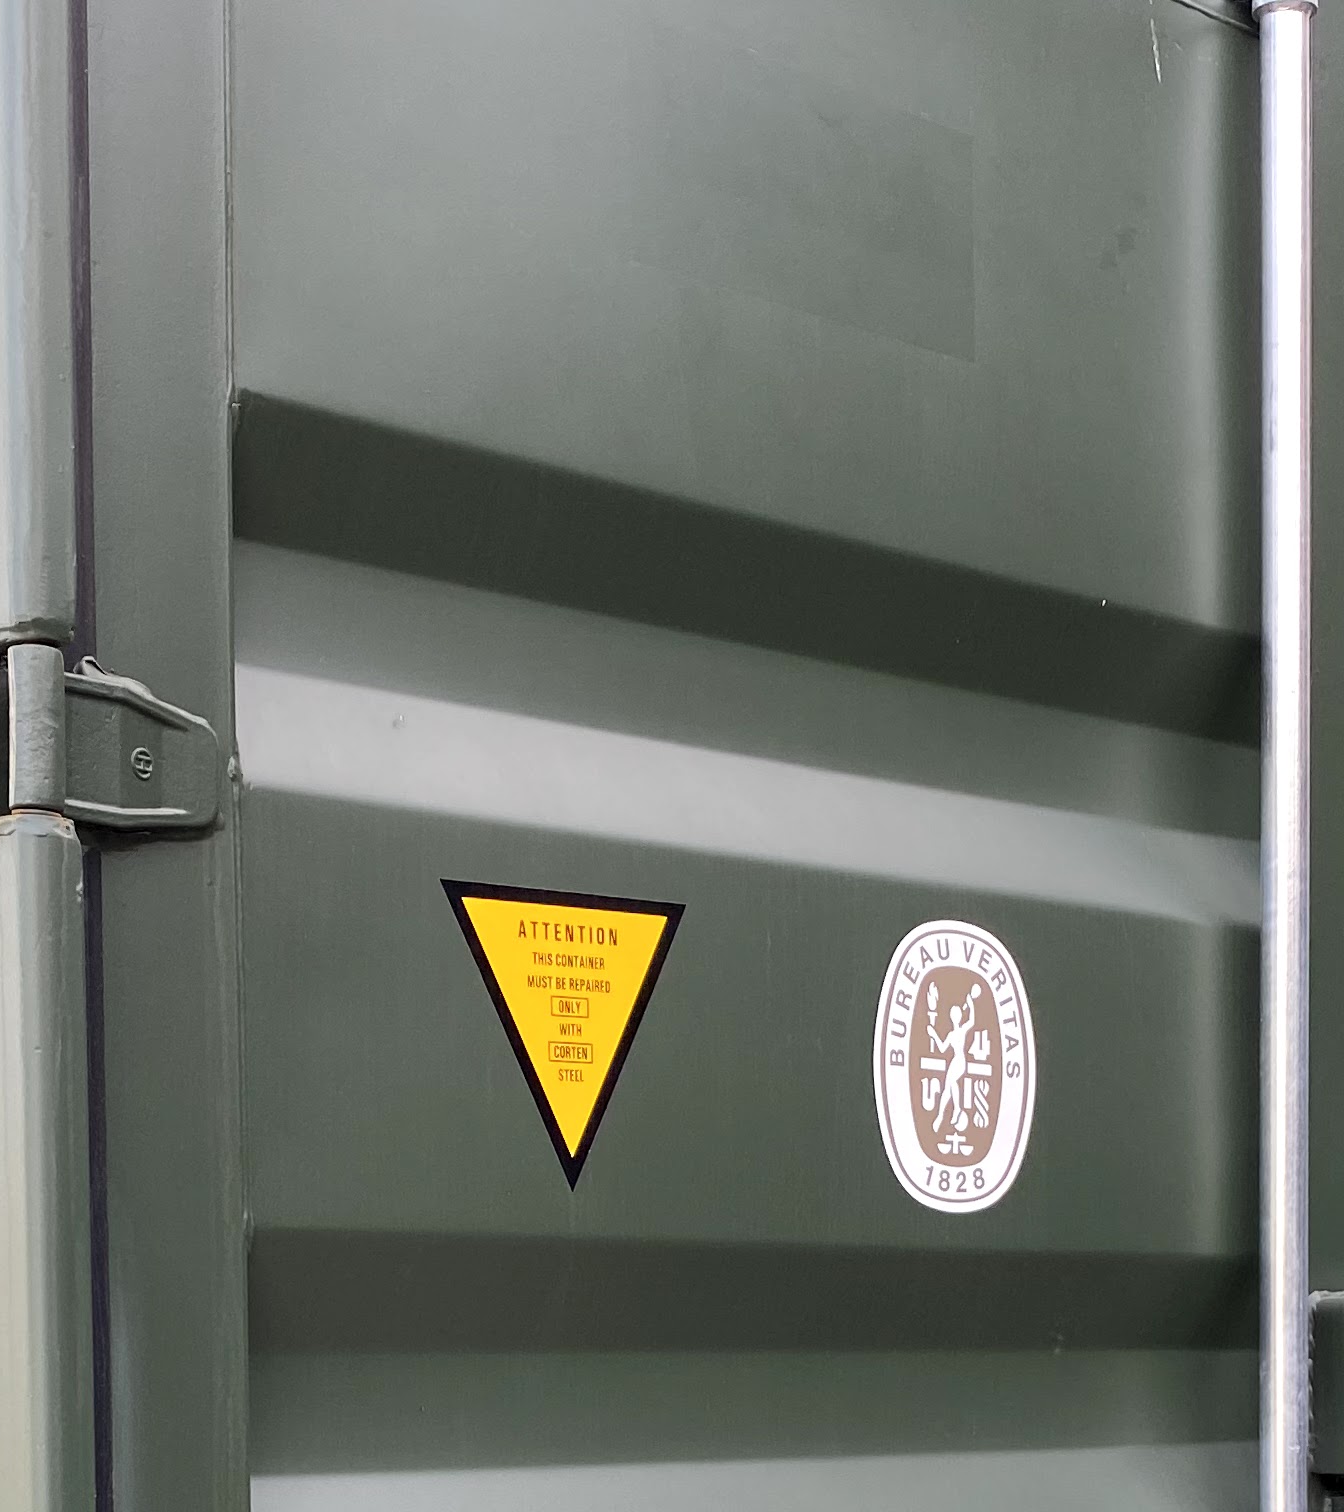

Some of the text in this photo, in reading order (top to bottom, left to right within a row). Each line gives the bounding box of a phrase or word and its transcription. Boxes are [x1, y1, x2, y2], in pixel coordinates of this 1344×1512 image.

[518, 919, 619, 946] ATTENTION
[532, 951, 605, 970] THIS CONTAINER
[527, 975, 611, 994] MUST BE REPAIRED
[558, 999, 582, 1015] ONLY
[890, 938, 1021, 1079] BUREAU VERITAS
[559, 1022, 582, 1037] WITH
[553, 1045, 589, 1061] CORTEN
[558, 1068, 584, 1083] STEEL
[925, 1166, 985, 1193] 1828
